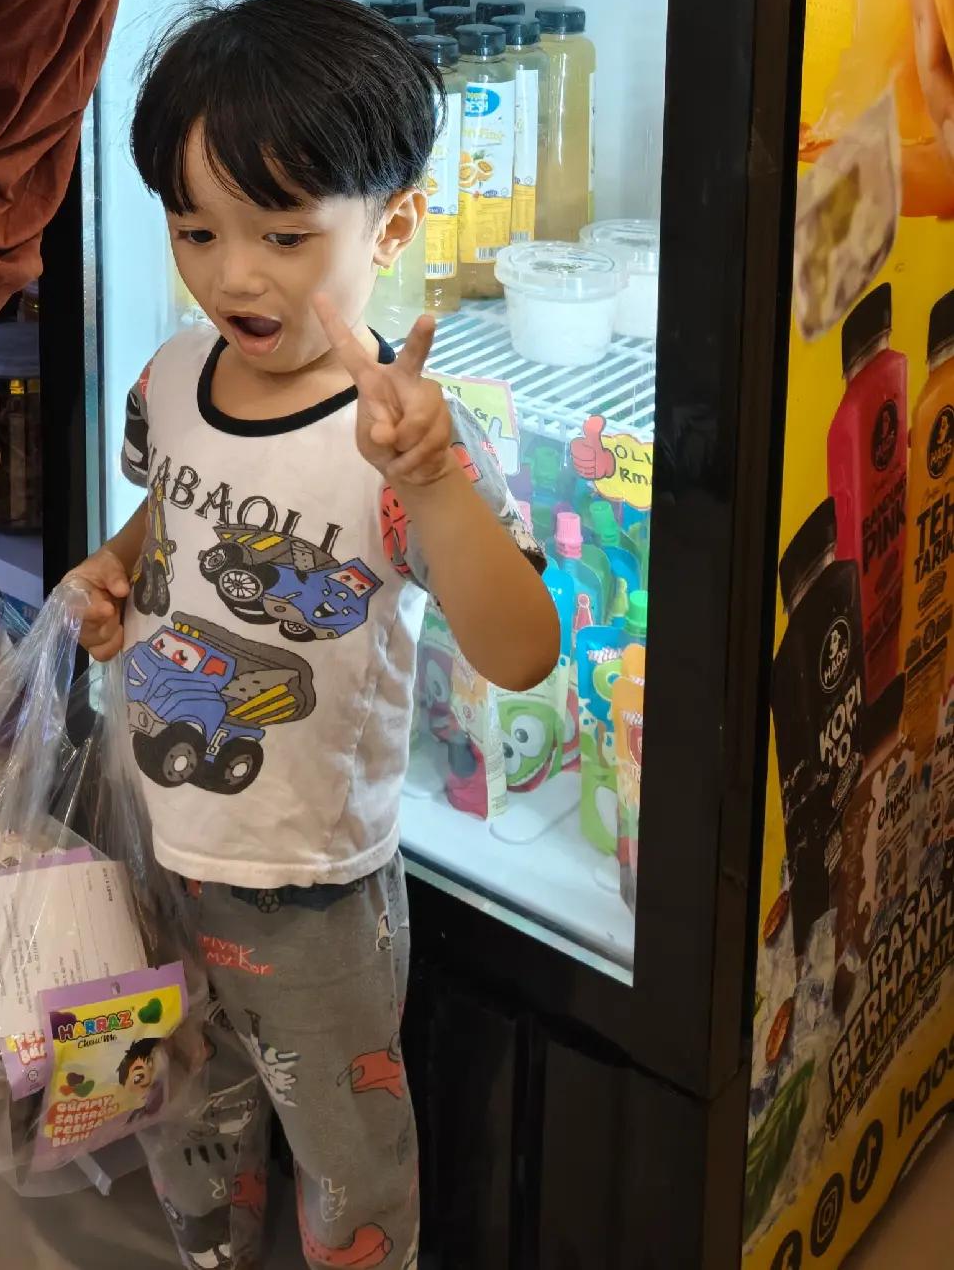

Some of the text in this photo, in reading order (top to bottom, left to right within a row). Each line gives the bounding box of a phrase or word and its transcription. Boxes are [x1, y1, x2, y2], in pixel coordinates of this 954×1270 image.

[819, 676, 861, 762] KOPI
[871, 882, 933, 989] RASA
[58, 1010, 134, 1043] HARRAZ
[54, 1103, 120, 1125] SAFFRON
[56, 1094, 114, 1113] GUMMY
